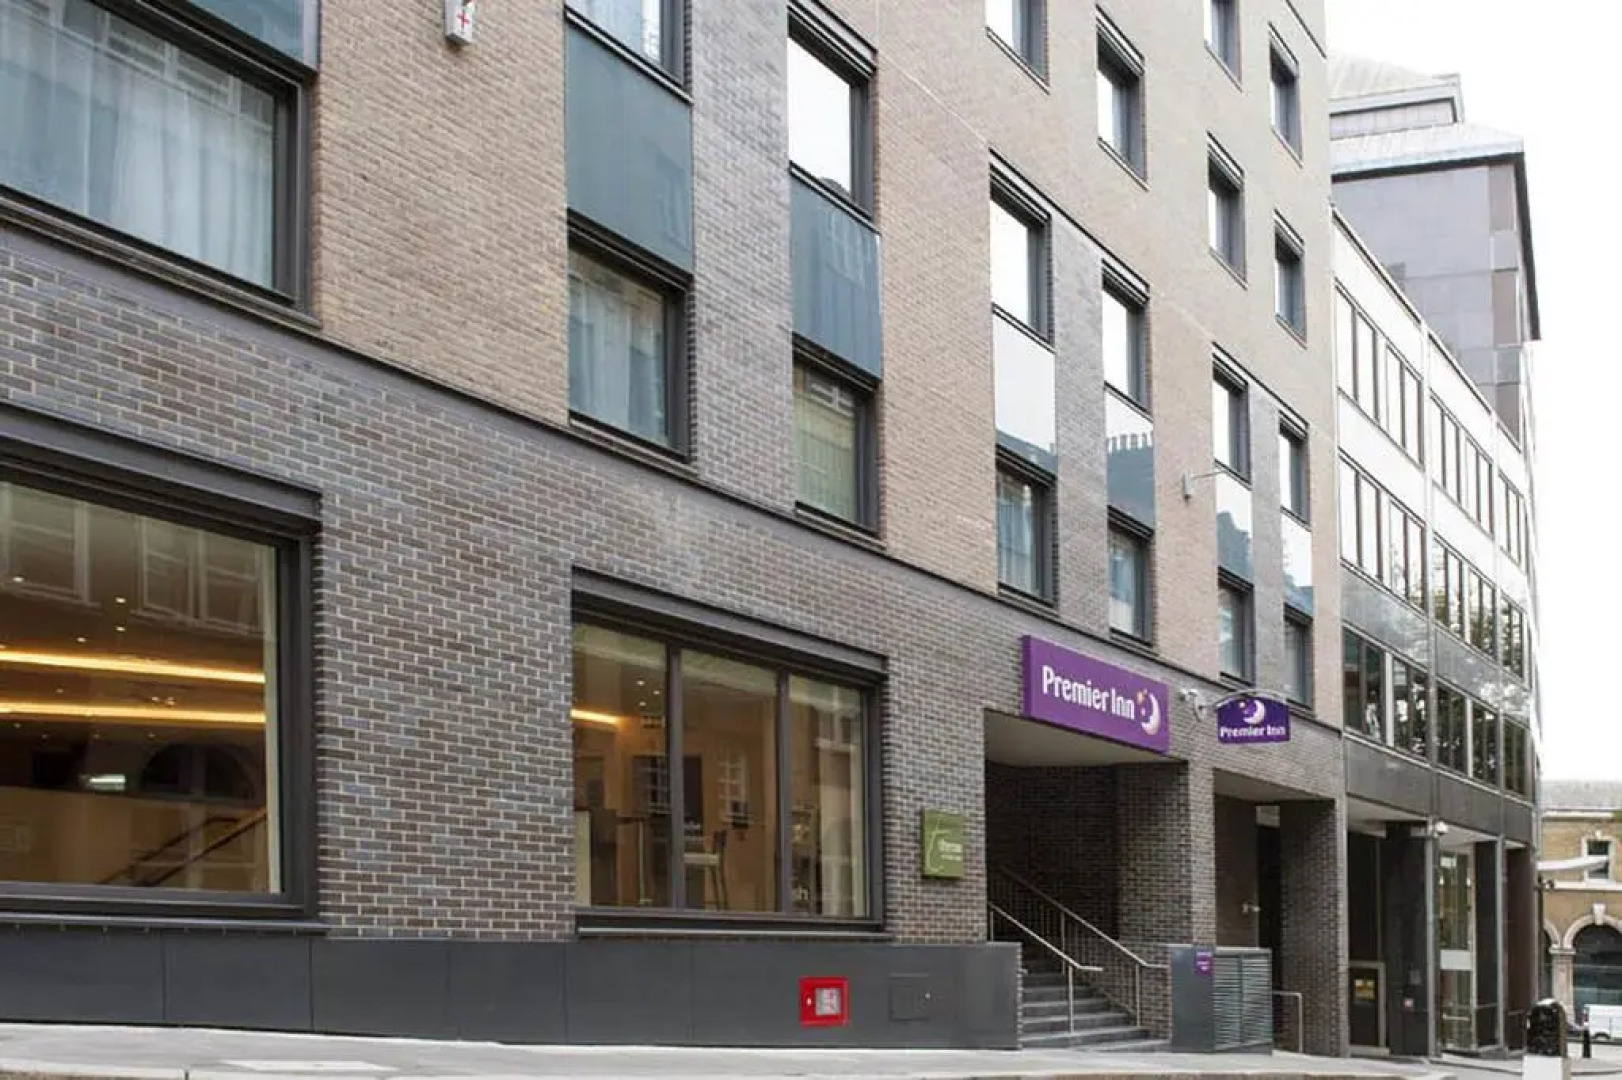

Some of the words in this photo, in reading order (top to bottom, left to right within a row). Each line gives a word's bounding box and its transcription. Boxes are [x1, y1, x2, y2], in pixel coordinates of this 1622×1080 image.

[1042, 665, 1109, 712] Premier
[1111, 688, 1135, 720] Inn
[1219, 726, 1264, 737] Premier
[1266, 726, 1285, 736] Inn
